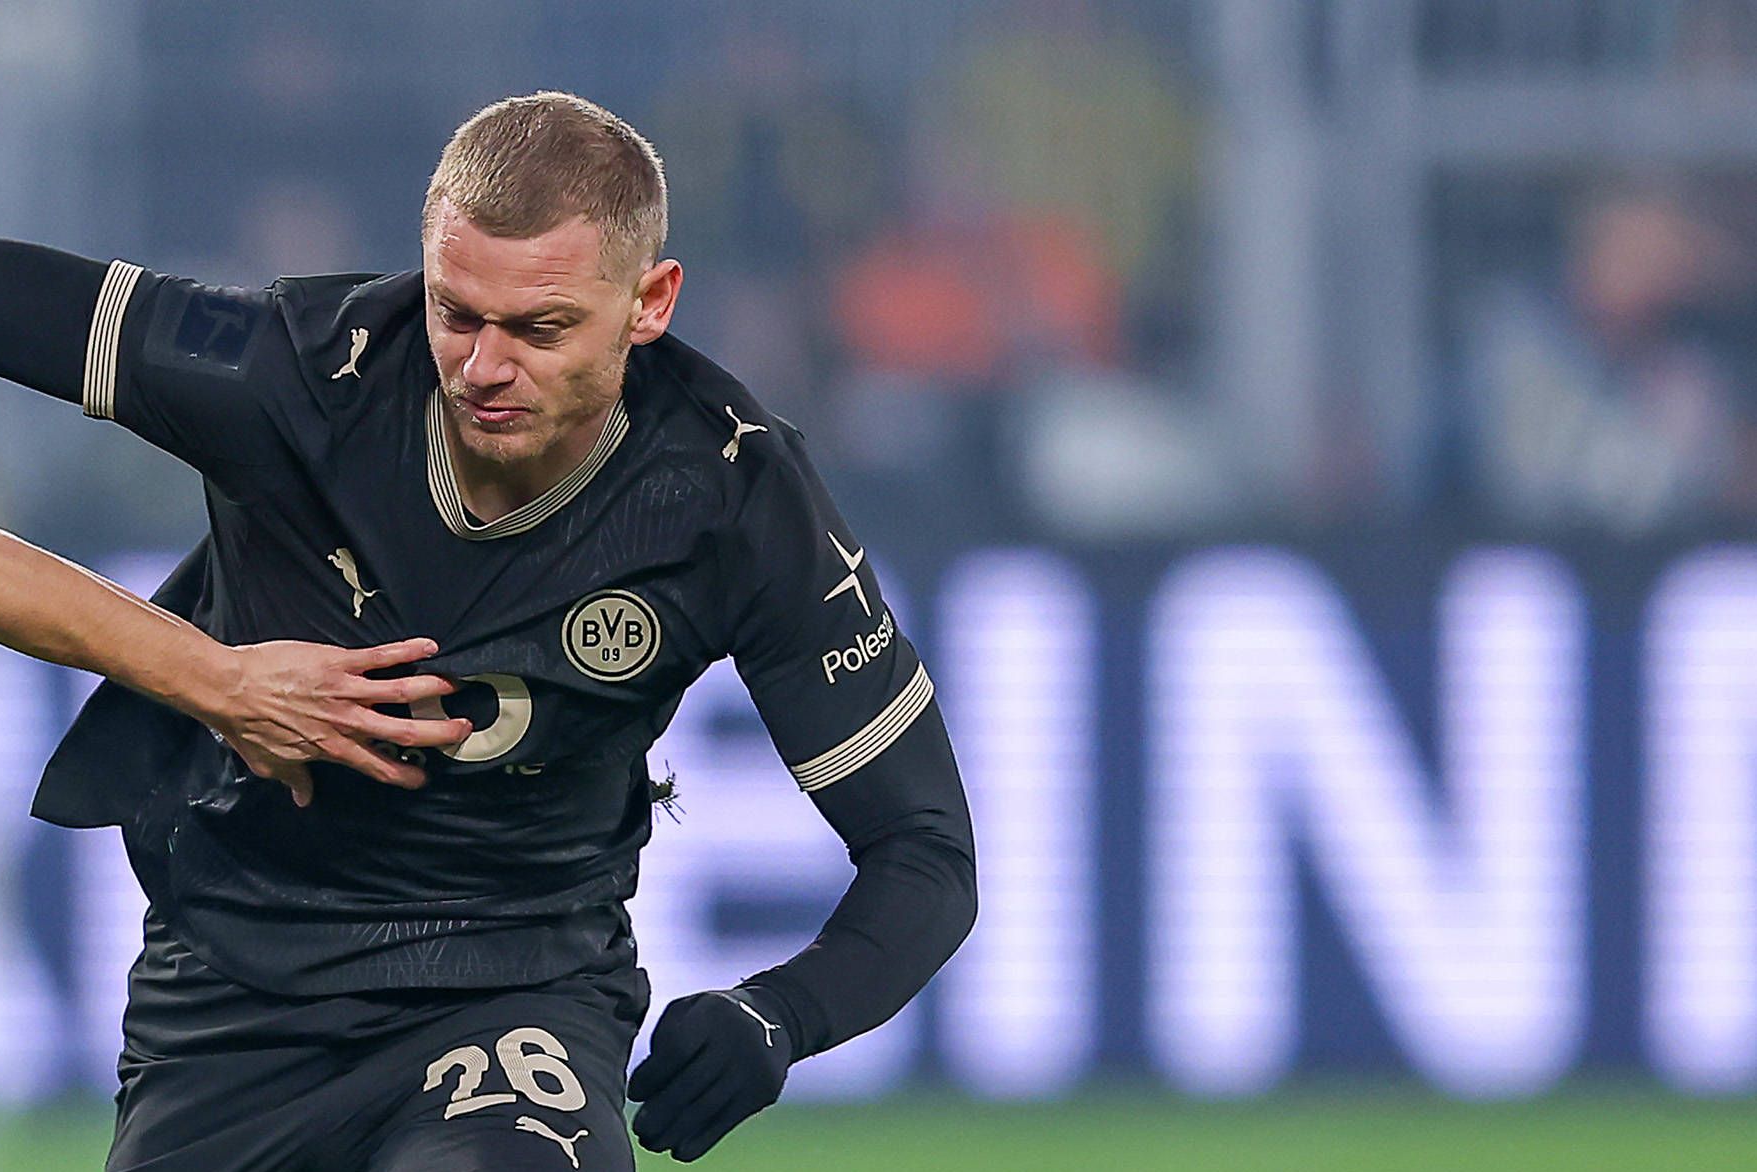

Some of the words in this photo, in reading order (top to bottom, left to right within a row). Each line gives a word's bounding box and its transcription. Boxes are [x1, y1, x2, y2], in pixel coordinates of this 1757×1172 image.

[582, 608, 644, 648] BVB
[601, 647, 621, 662] 09
[422, 1026, 587, 1121] 26
